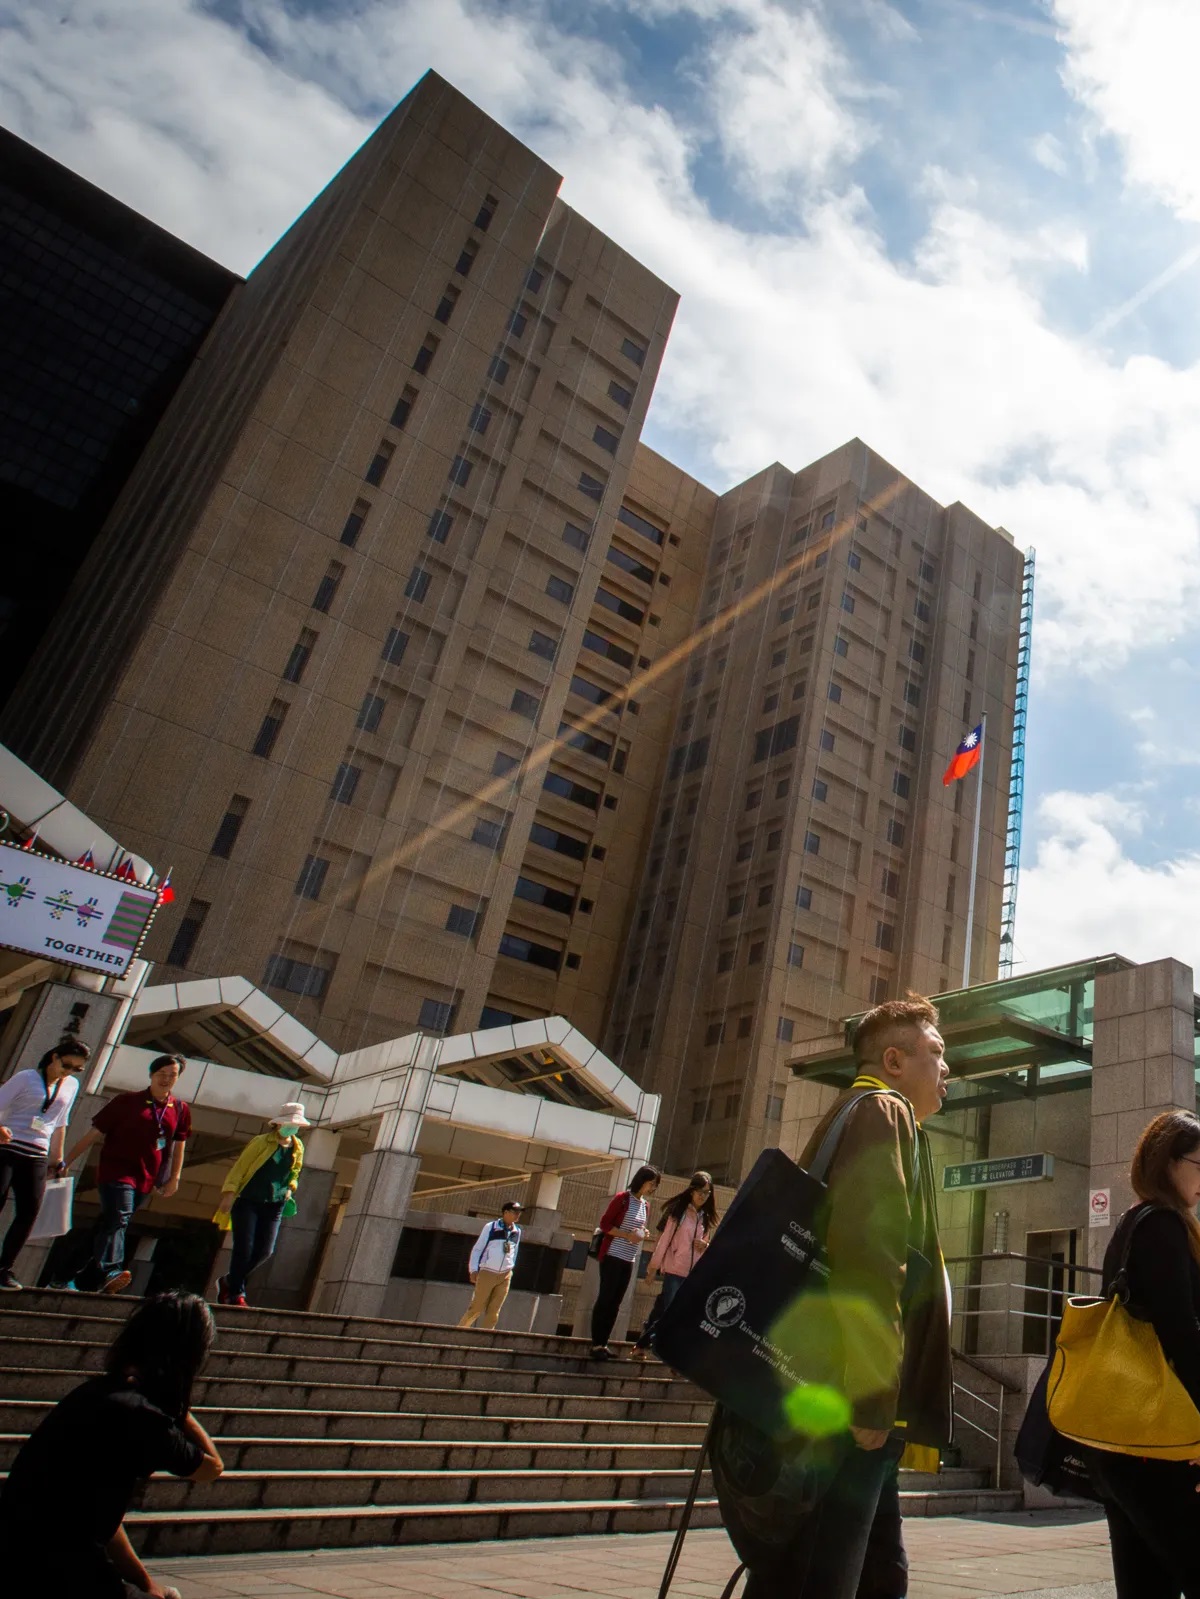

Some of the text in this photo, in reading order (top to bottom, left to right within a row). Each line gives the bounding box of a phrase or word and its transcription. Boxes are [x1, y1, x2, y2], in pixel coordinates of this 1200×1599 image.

[44, 937, 125, 966] TOGETHER
[990, 1170, 1015, 1180] ELEVATOR
[739, 1320, 761, 1342] Taiwan
[760, 1335, 784, 1358] Society
[752, 1344, 809, 1388] Internal Medicine
